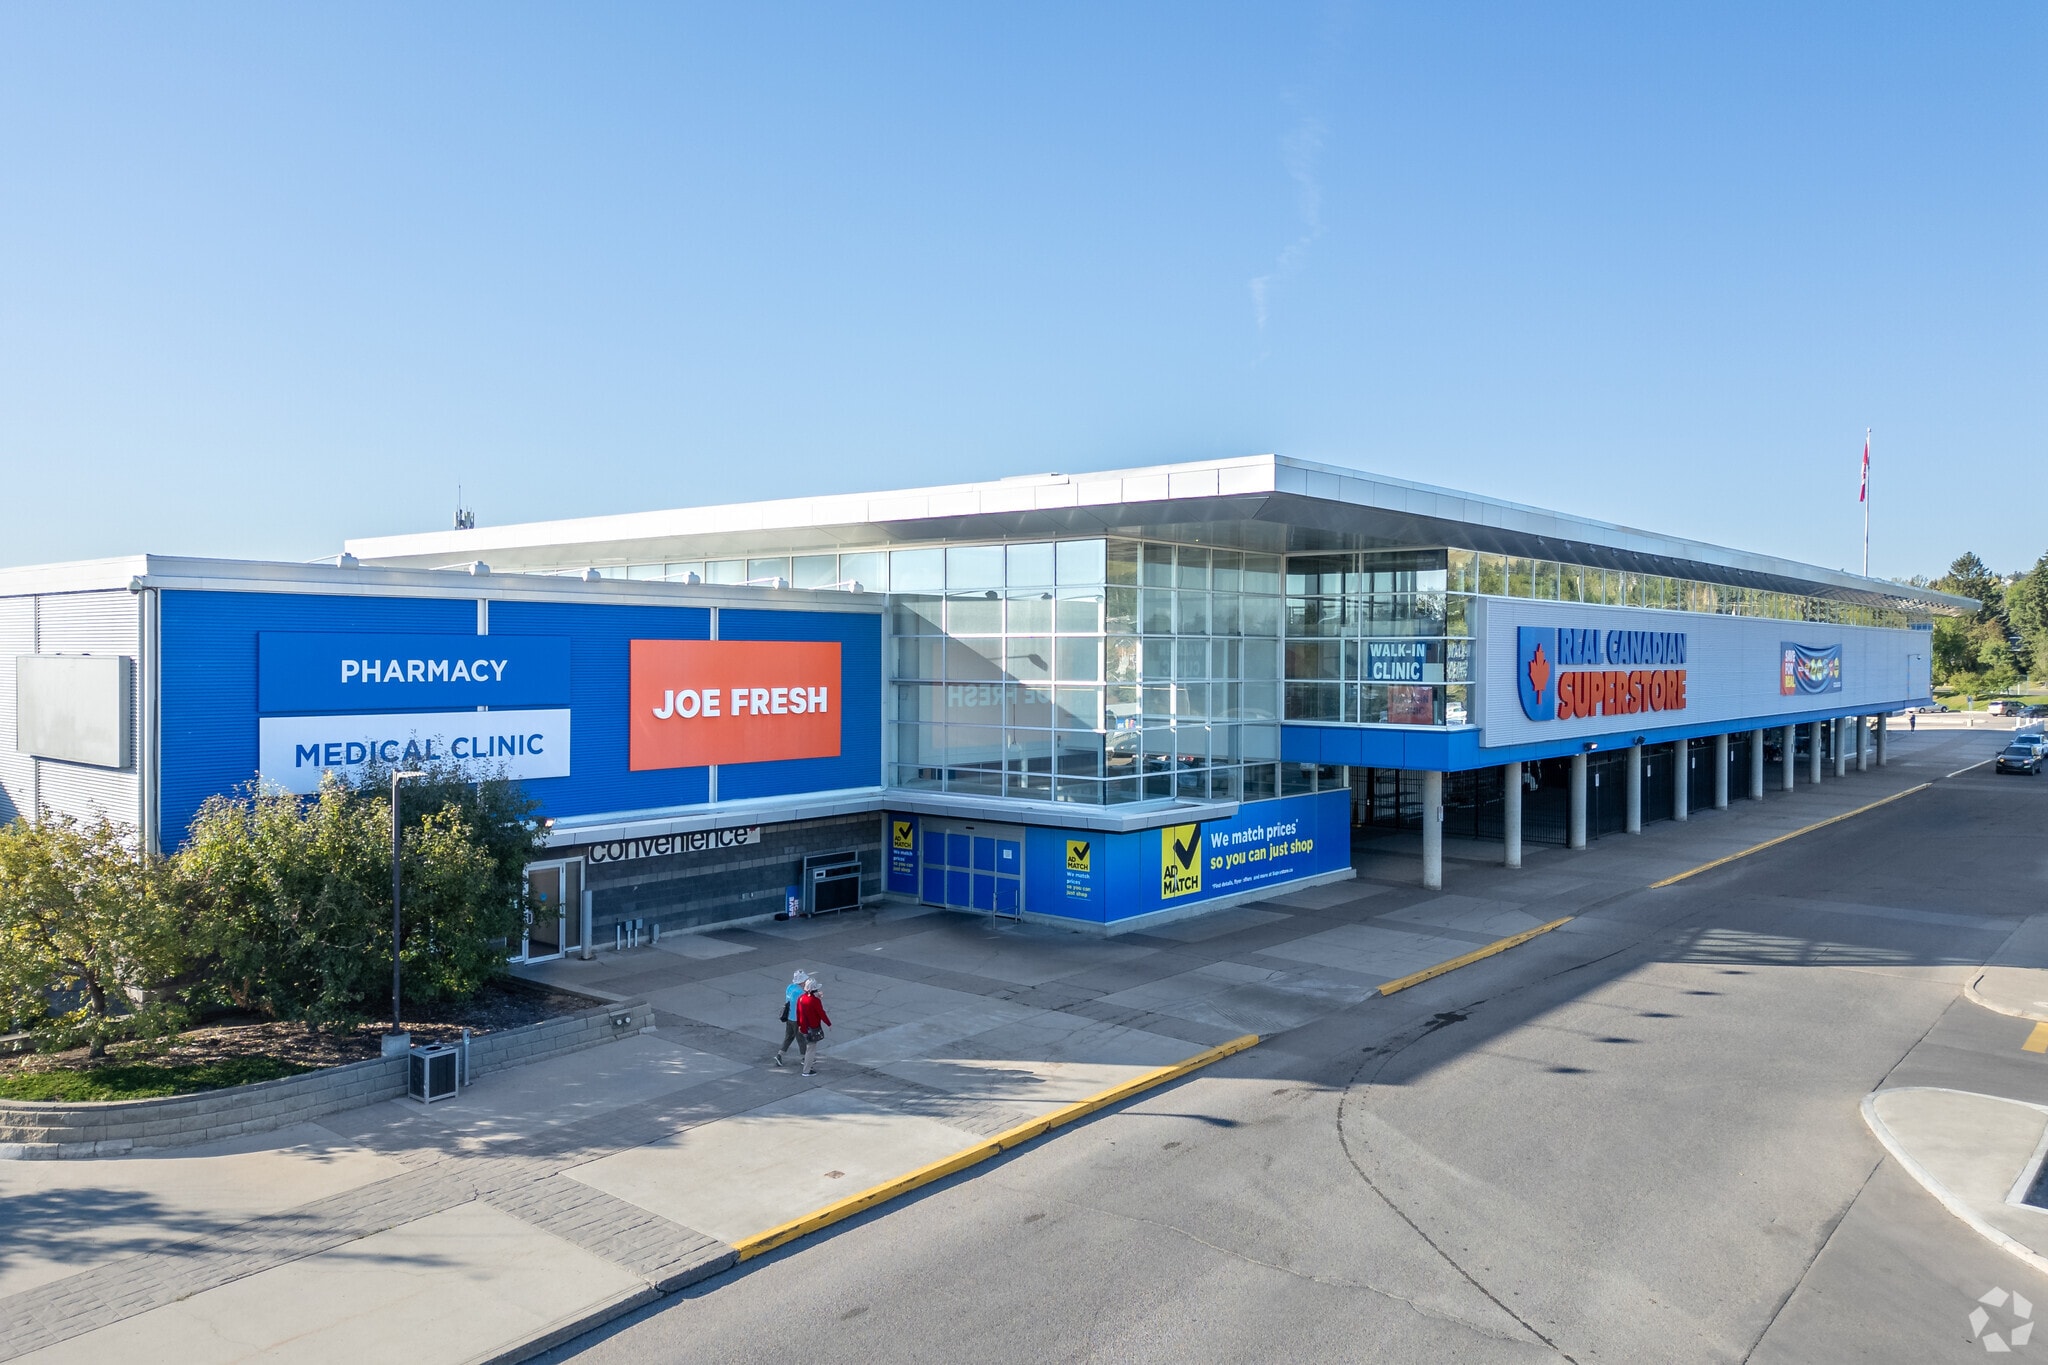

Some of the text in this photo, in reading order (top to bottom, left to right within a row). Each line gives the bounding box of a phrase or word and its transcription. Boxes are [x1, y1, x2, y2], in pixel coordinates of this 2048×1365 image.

[1370, 643, 1425, 657] WALK-IN
[1558, 628, 1687, 665] REAL CANADIAN
[341, 659, 508, 683] PHARMACY
[1373, 662, 1420, 680] CLINIC
[652, 686, 828, 720] JOE FRESH
[1558, 670, 1687, 720] SUPERSTORE
[295, 734, 544, 767] MEDICAL CLINIC
[589, 827, 748, 863] convenience
[1211, 832, 1229, 848] We
[1232, 825, 1264, 845] match
[1068, 862, 1088, 870] MATCH
[1211, 838, 1313, 870] so you can just shop
[1164, 865, 1178, 880] AD
[1164, 875, 1198, 895] MATCH
